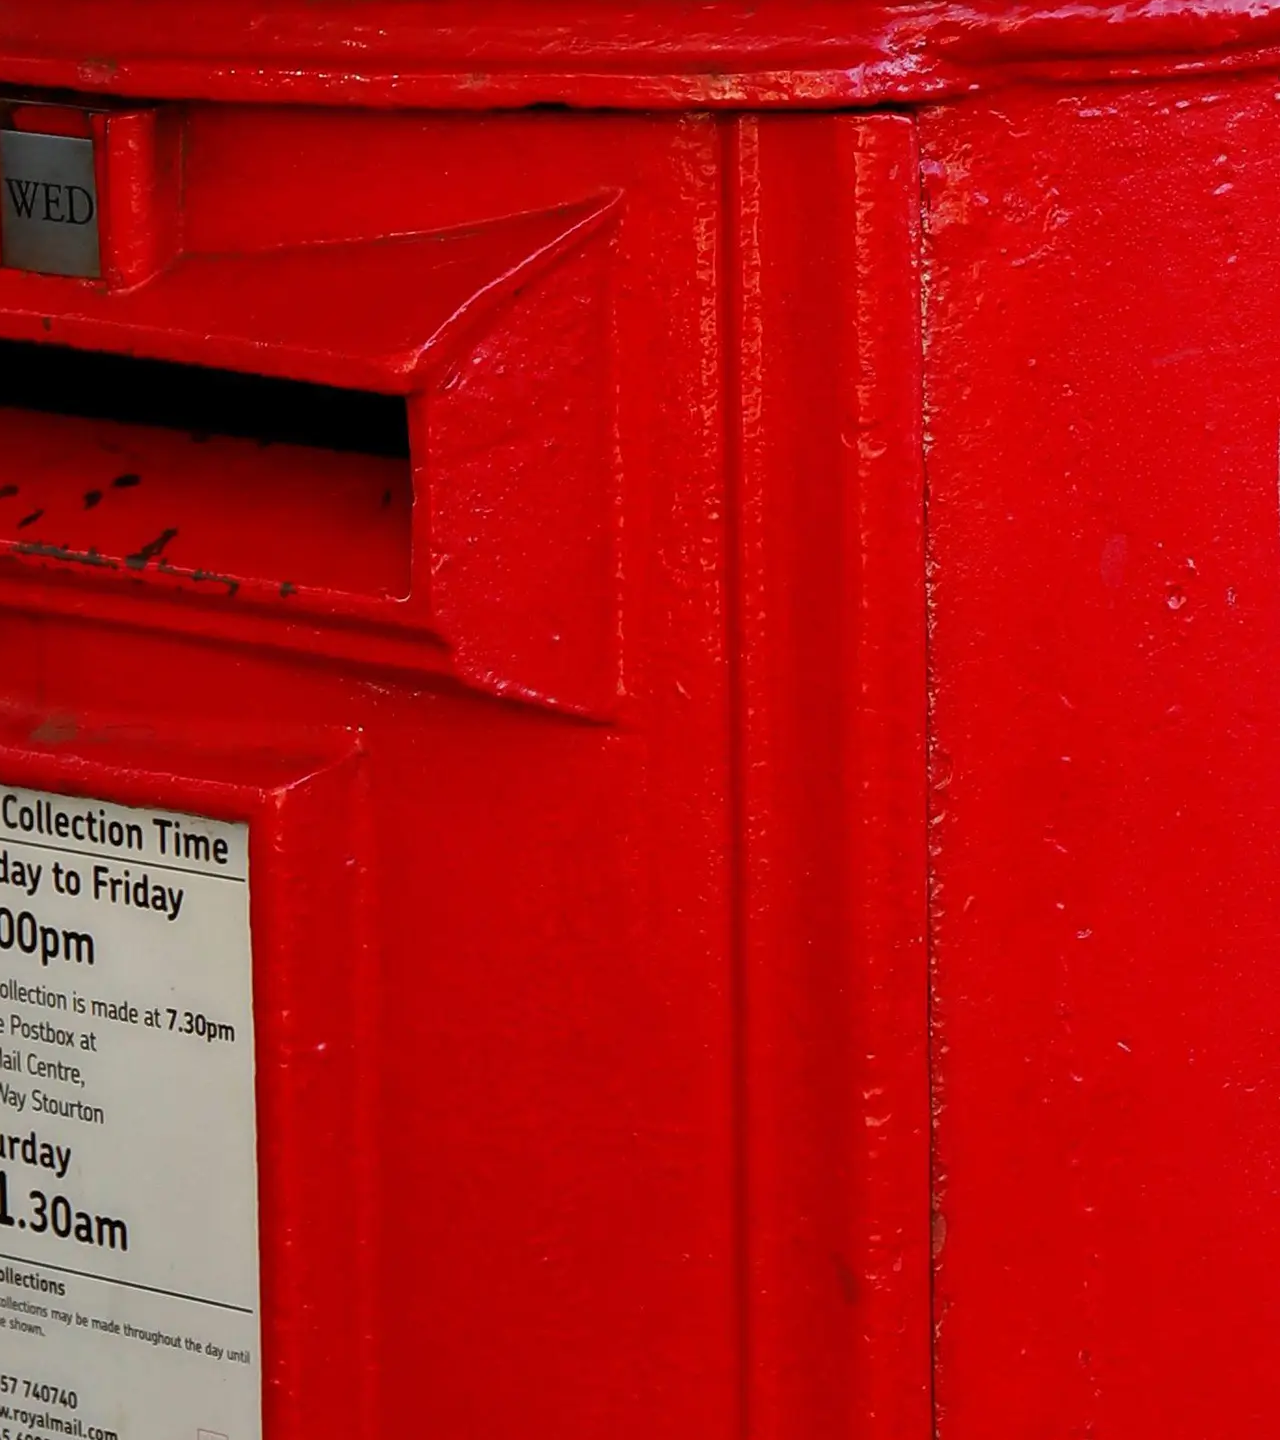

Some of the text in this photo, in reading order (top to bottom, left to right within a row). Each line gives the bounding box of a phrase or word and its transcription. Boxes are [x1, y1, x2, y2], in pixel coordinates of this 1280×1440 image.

[5, 178, 94, 225] WED
[1, 793, 143, 851] Collection
[151, 817, 229, 865] Time
[51, 861, 81, 896] to
[93, 864, 184, 922] Friday
[10, 1013, 75, 1048] Postbox
[79, 1031, 98, 1052] at
[72, 990, 87, 1014] is
[90, 1000, 139, 1025] made
[143, 1007, 162, 1029] at
[165, 1008, 235, 1043] 7.30pm
[26, 1052, 86, 1088] Centre,
[31, 1088, 105, 1125] Stourton
[50, 1309, 73, 1326] may
[75, 1311, 89, 1328] be
[91, 1318, 121, 1335] made
[122, 1323, 183, 1349] throughout
[184, 1337, 203, 1354] the
[204, 1342, 224, 1361] day
[226, 1349, 251, 1365] until
[22, 1379, 78, 1410] 740740
